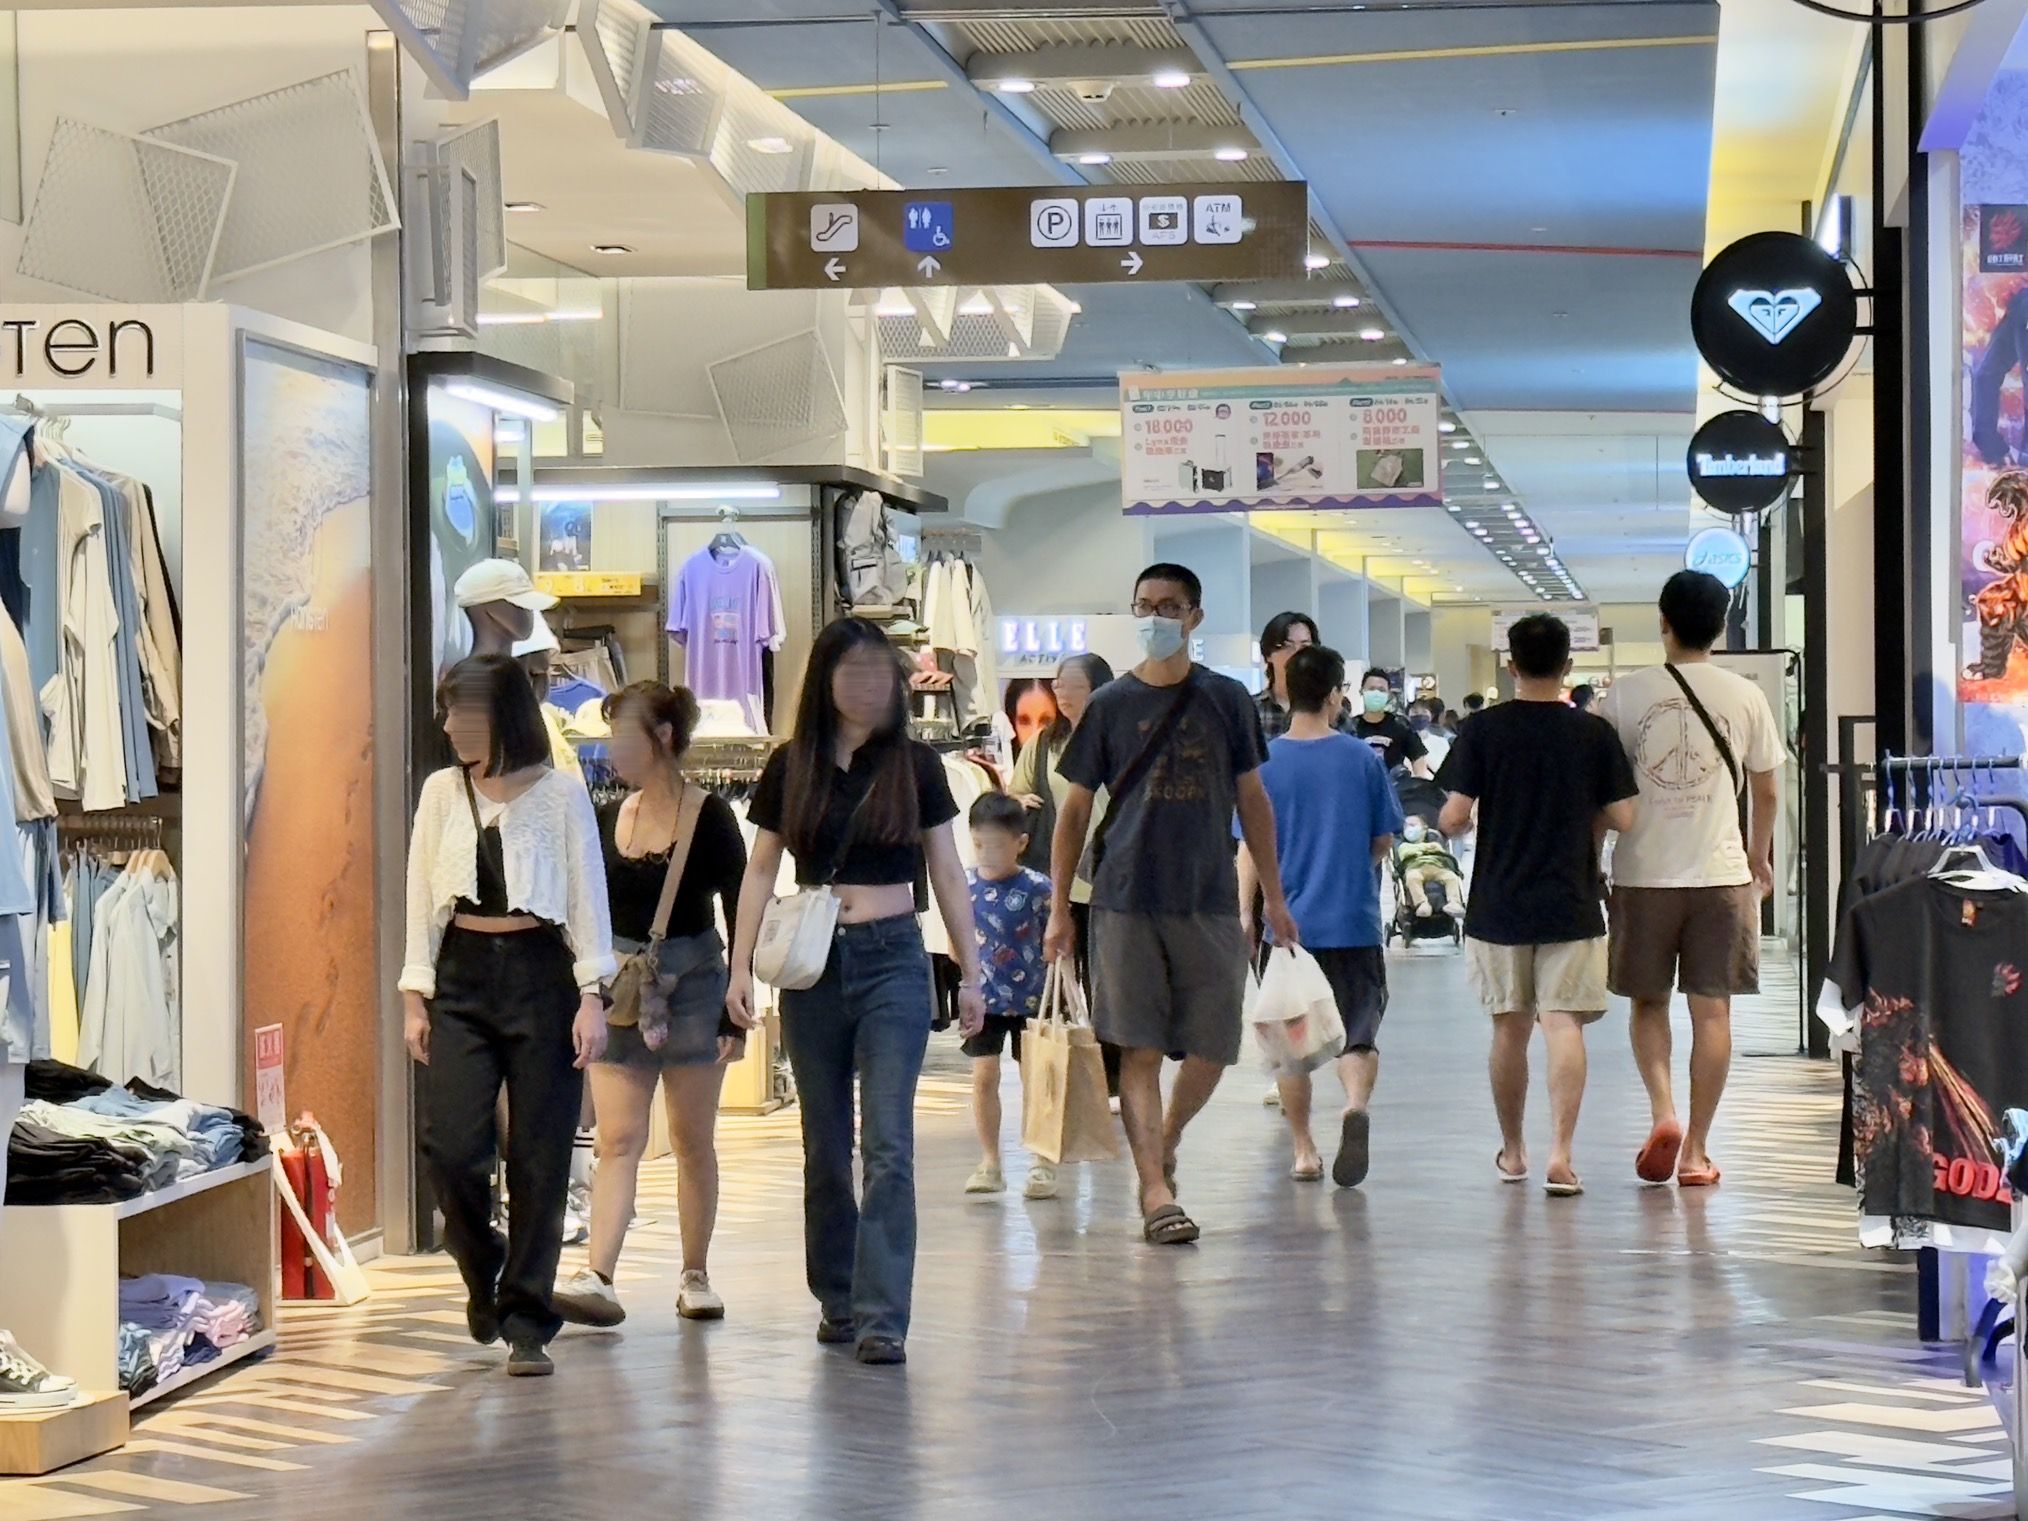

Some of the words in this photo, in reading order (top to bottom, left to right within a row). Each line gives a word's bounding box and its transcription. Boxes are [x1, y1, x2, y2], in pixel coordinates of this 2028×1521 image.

[1205, 202, 1232, 214] ATM
[1696, 453, 1785, 476] Timberland
[1003, 621, 1087, 652] ELLE
[1020, 652, 1068, 665] ACTIV
